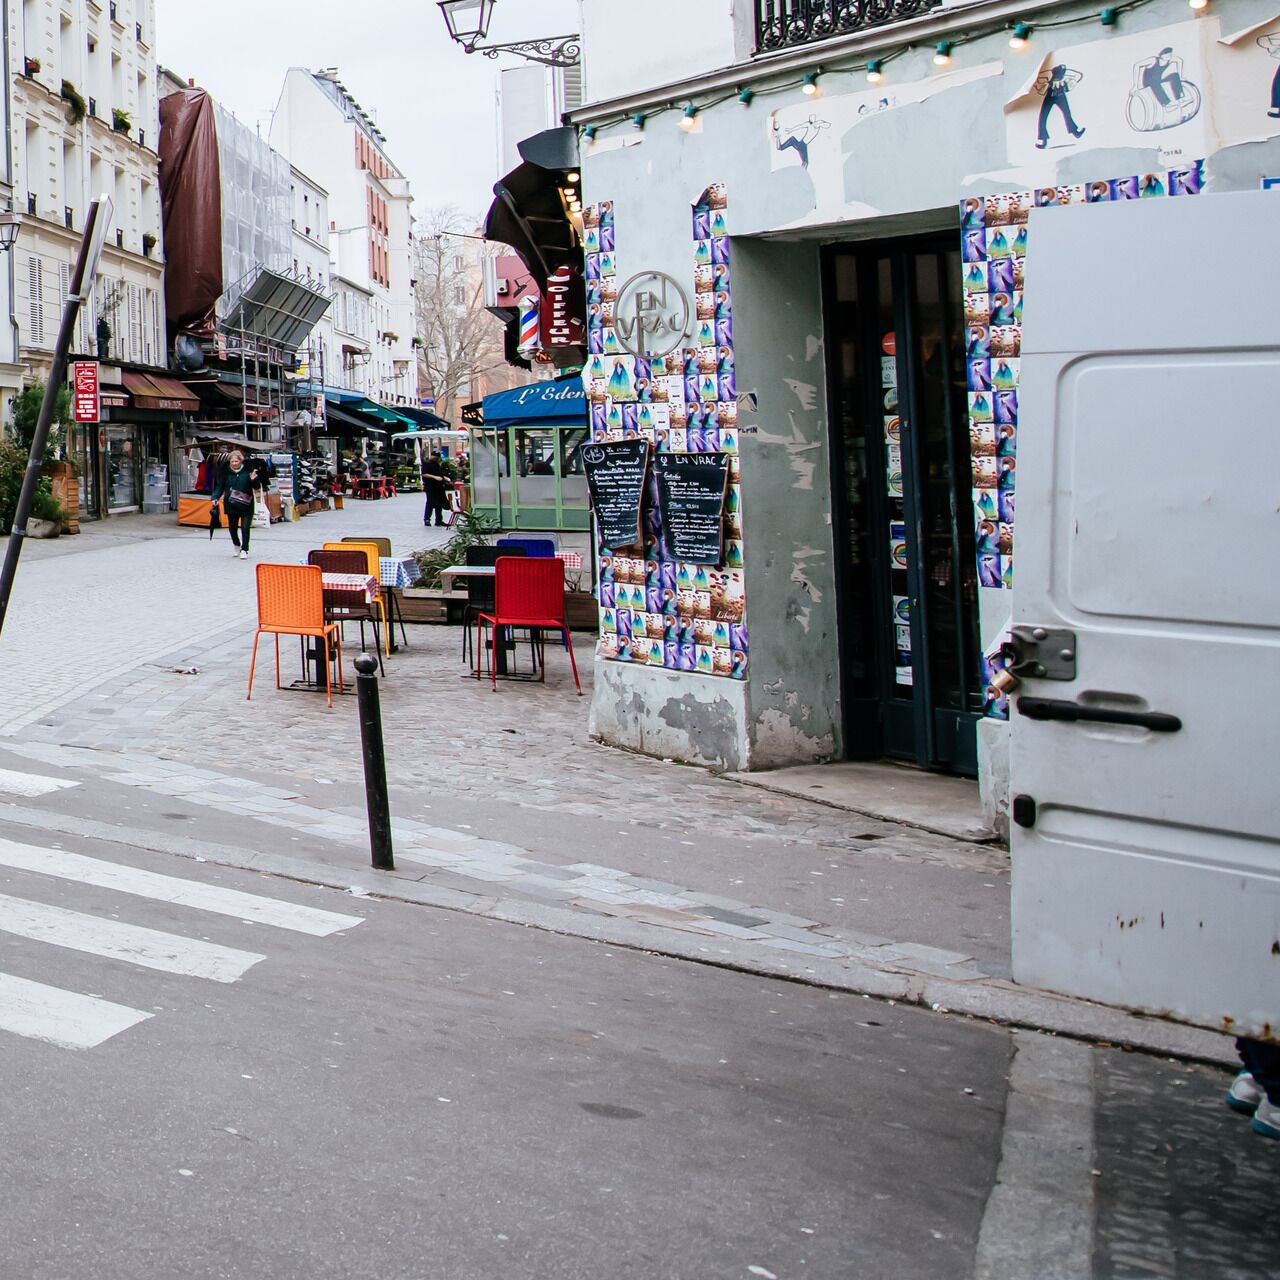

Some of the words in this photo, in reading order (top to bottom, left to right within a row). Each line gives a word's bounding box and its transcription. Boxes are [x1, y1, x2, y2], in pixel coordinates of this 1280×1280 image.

[635, 287, 666, 311] EN
[617, 313, 682, 341] VRAC
[675, 455, 689, 464] EN
[690, 455, 717, 466] VRAC
